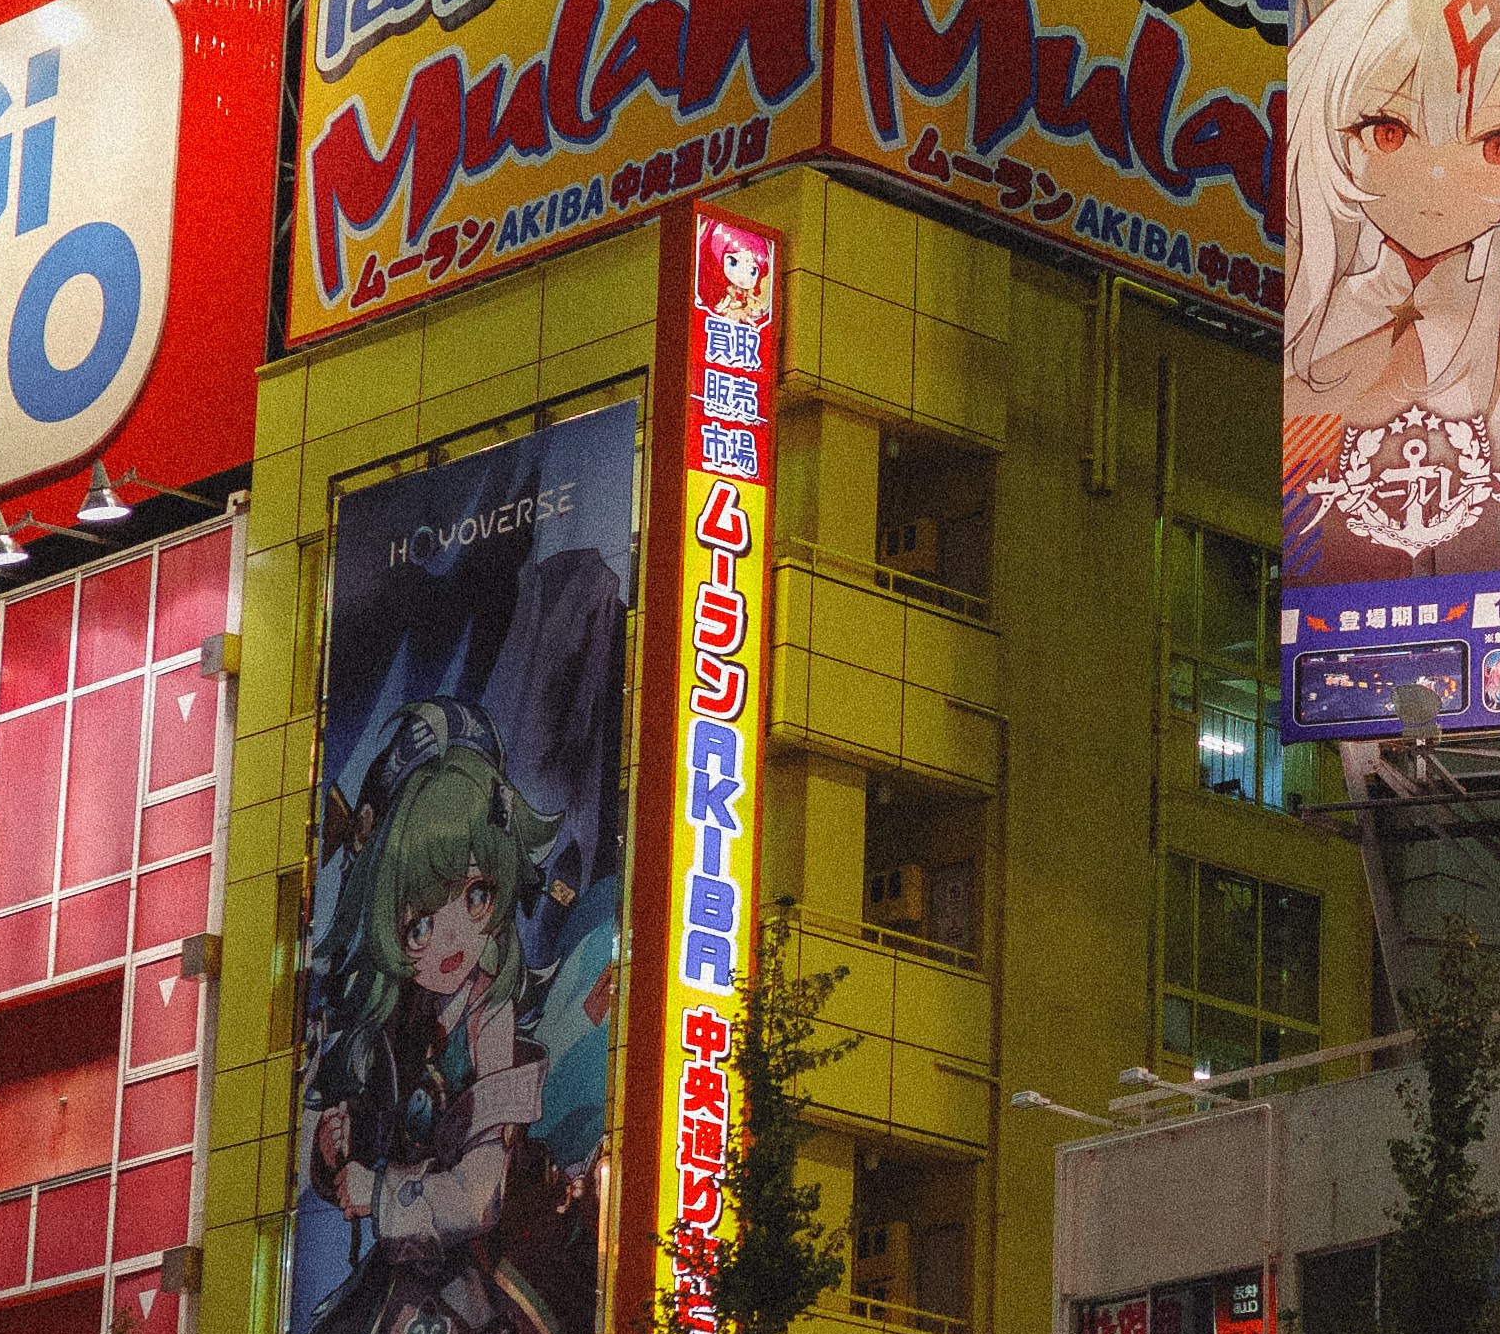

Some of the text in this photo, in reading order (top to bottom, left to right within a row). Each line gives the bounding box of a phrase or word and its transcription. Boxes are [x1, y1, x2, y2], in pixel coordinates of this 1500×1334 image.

[704, 317, 761, 368] 買取
[704, 369, 759, 419] 販売
[701, 422, 758, 474] 市場
[389, 482, 577, 567] HOYOVERSE
[1339, 604, 1439, 631] 登場期間
